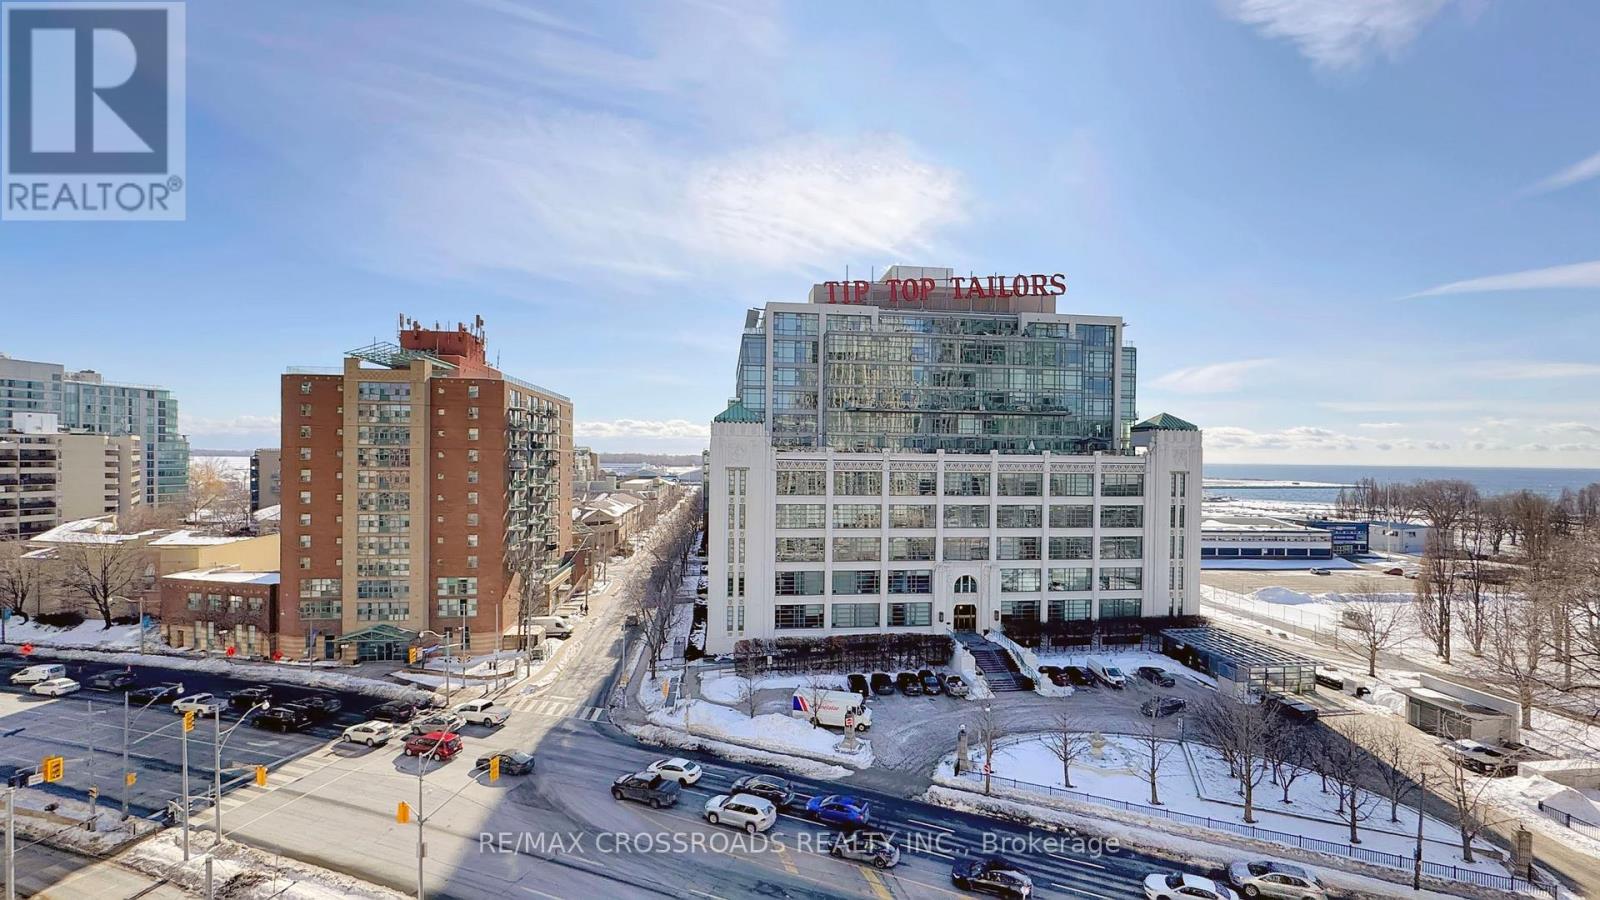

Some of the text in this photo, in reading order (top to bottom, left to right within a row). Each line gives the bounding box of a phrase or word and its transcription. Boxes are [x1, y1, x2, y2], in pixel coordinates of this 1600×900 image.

[824, 273, 1067, 305] TIP TOP TAILORS
